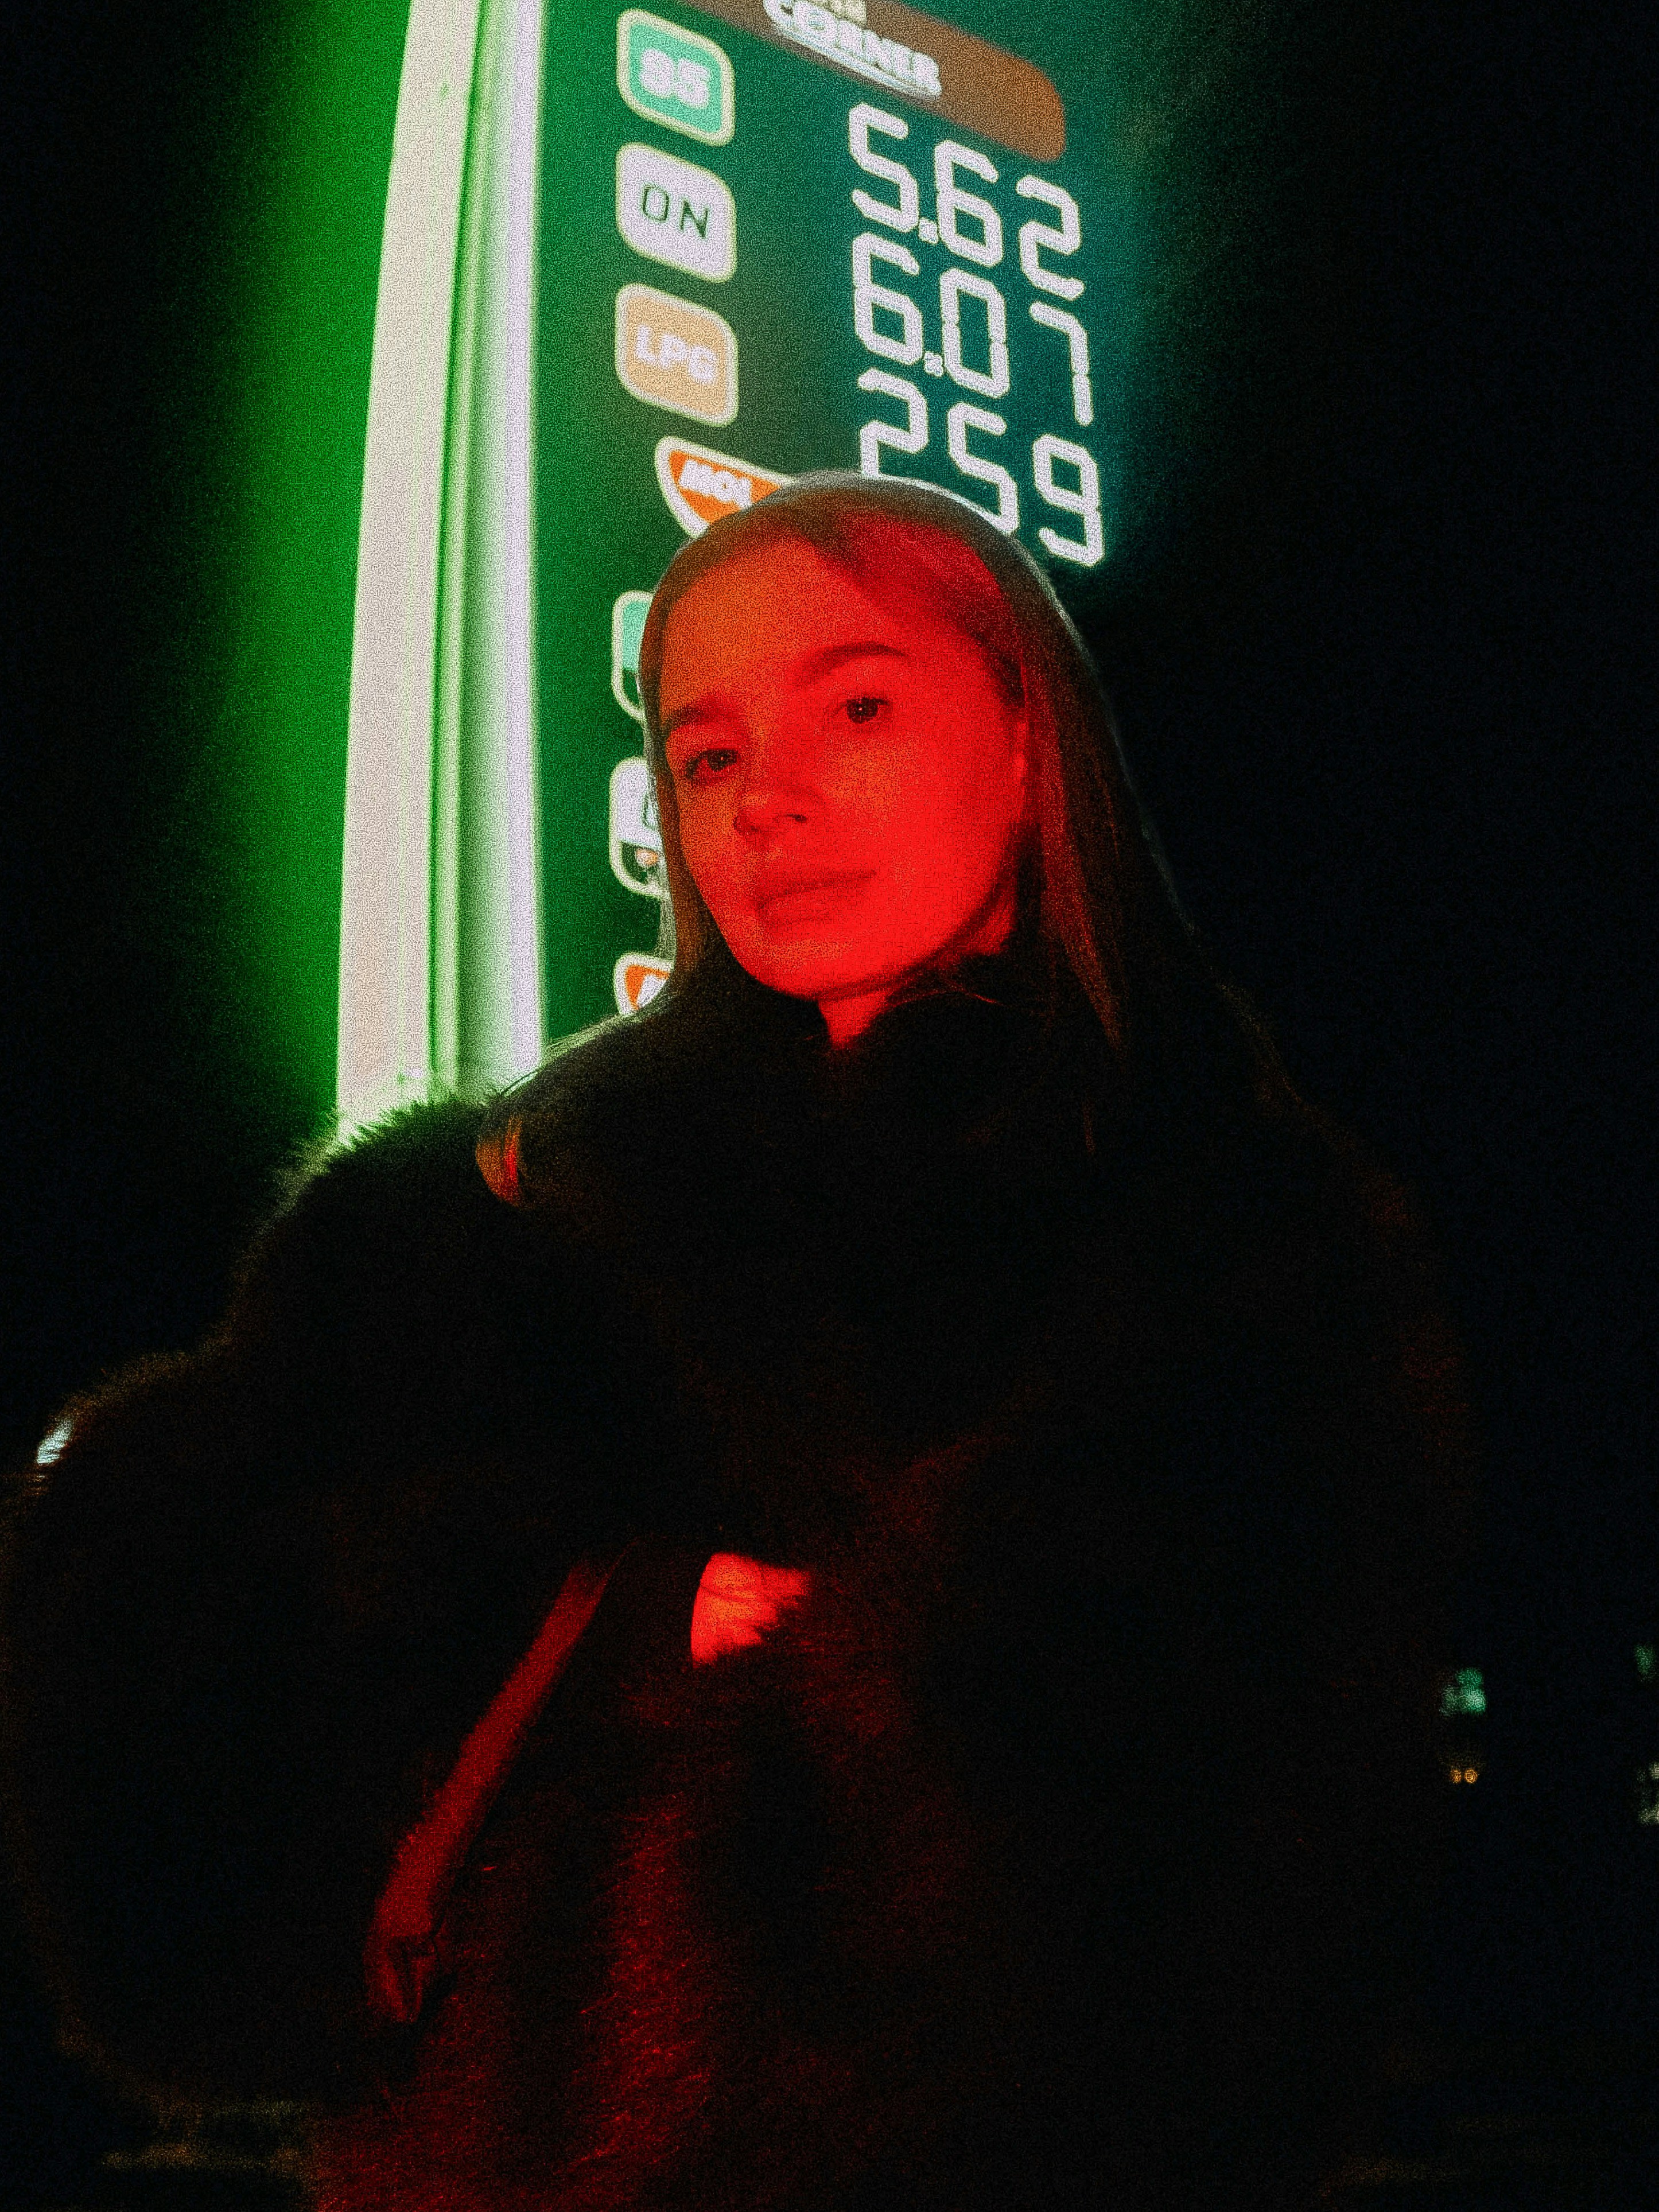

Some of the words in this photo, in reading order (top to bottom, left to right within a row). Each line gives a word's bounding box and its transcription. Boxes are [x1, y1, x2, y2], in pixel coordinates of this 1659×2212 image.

[641, 185, 709, 239] ON
[849, 102, 1085, 300] 5.62
[635, 324, 718, 384] LPG
[851, 232, 1092, 425] 6.07
[858, 368, 1105, 566] 259
